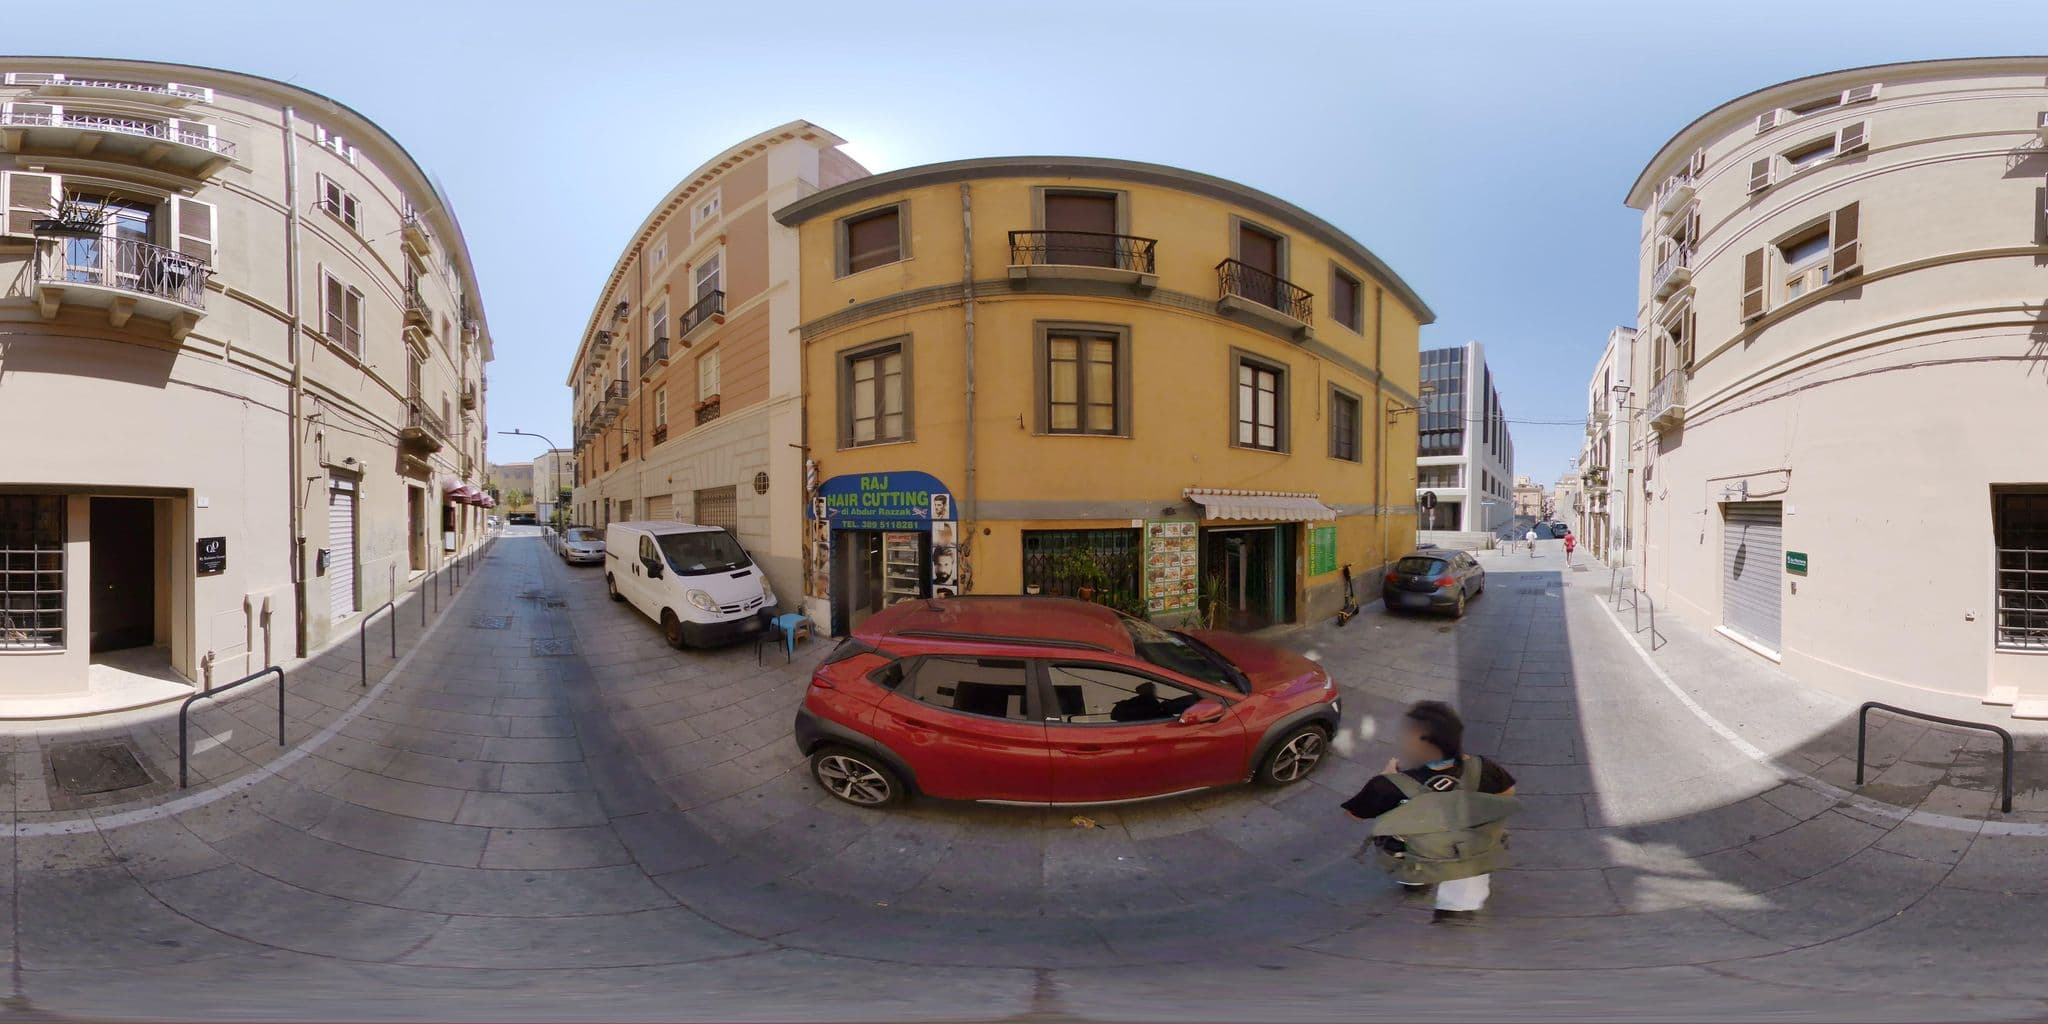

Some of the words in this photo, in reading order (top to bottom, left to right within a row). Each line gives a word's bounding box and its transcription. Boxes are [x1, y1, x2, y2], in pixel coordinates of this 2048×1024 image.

[861, 477, 888, 490] RAJ
[827, 494, 858, 506] HAIR
[863, 491, 928, 506] CUTTING
